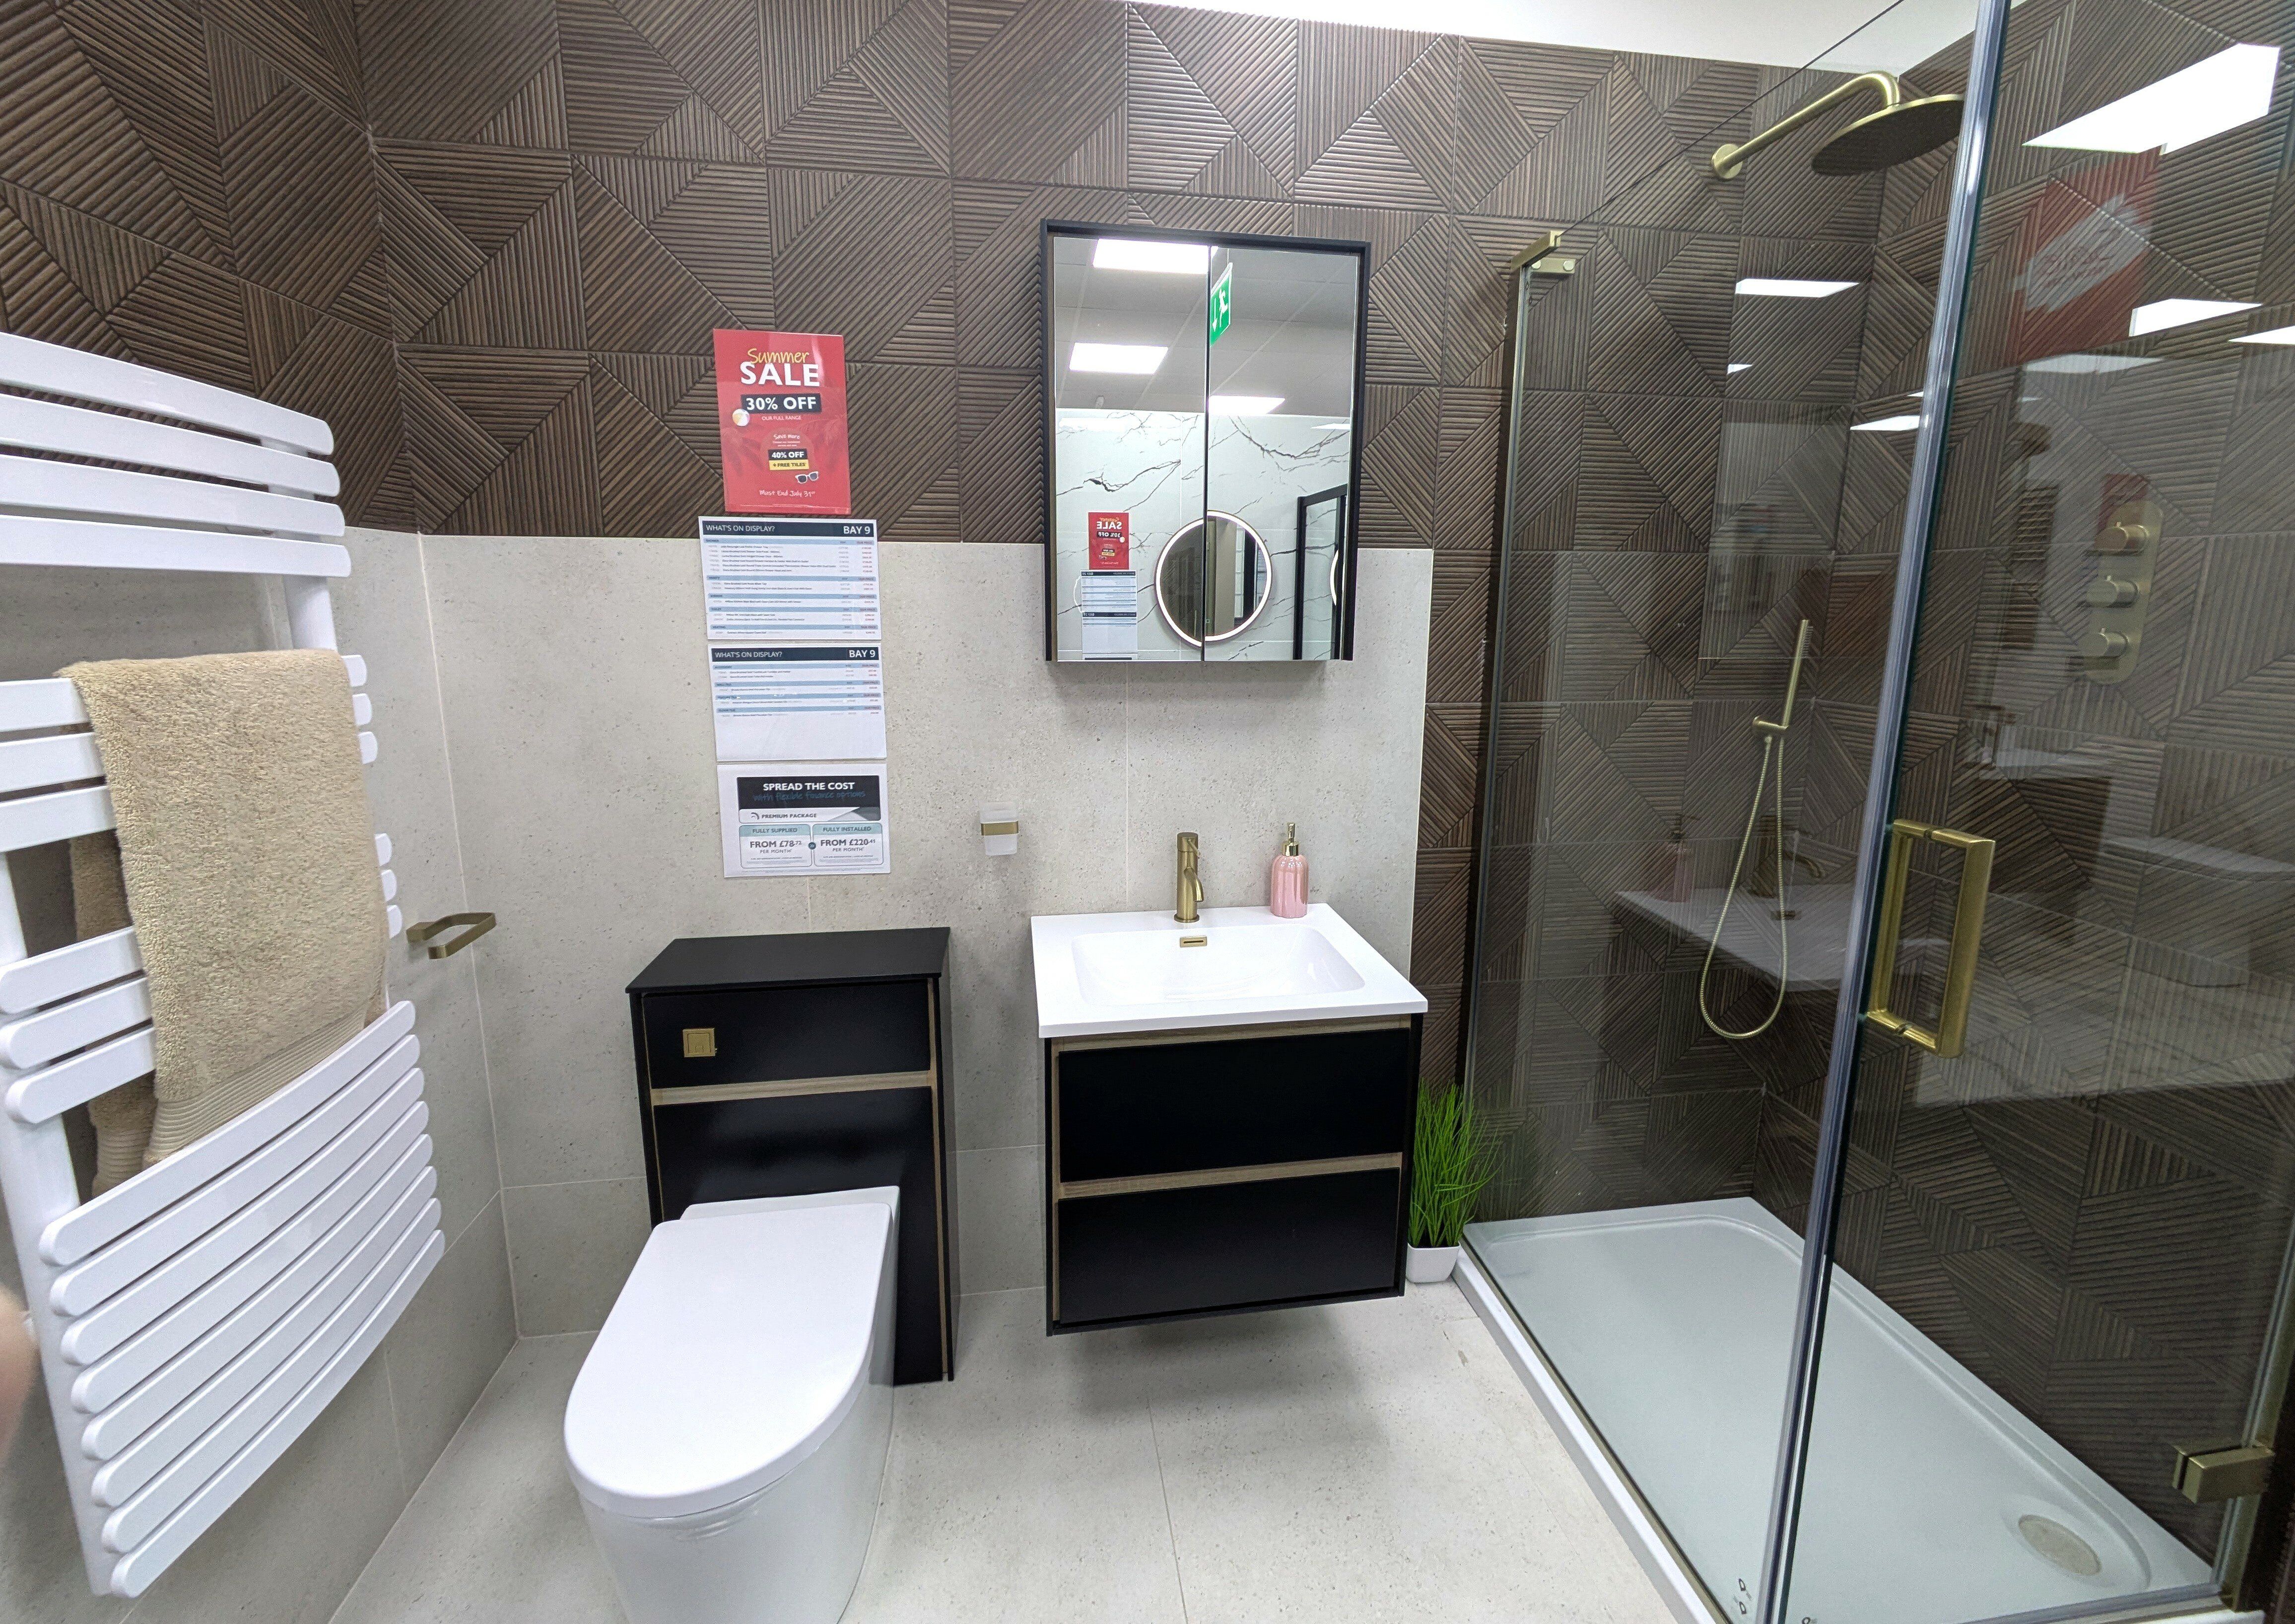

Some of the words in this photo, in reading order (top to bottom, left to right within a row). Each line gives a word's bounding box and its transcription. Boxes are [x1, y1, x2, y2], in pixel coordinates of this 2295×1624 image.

[747, 348, 810, 364] Summer
[740, 361, 820, 387] SALE
[746, 397, 778, 410] 30%
[783, 397, 816, 410] OFF
[843, 526, 862, 534] BAY
[763, 783, 803, 791] SPREAD
